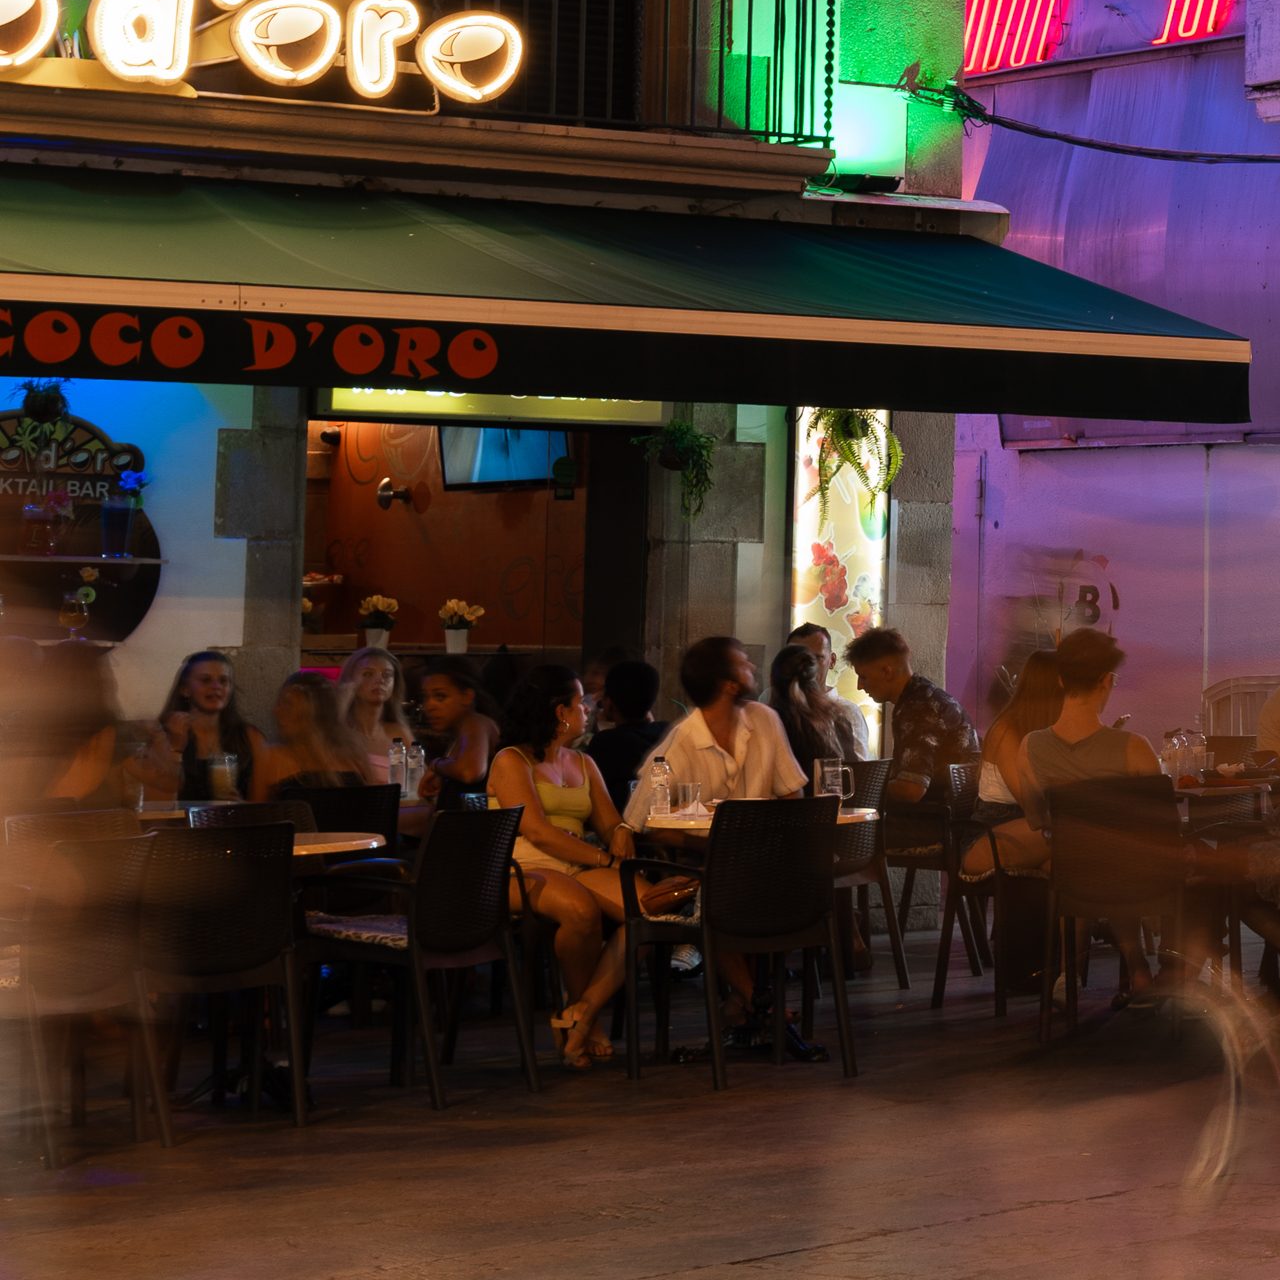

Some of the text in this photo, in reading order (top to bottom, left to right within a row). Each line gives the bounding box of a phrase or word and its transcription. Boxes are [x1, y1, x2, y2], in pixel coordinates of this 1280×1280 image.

[0, 309, 499, 380] OCO D'ORO
[66, 480, 110, 498] BAR
[1074, 584, 1101, 626] B
